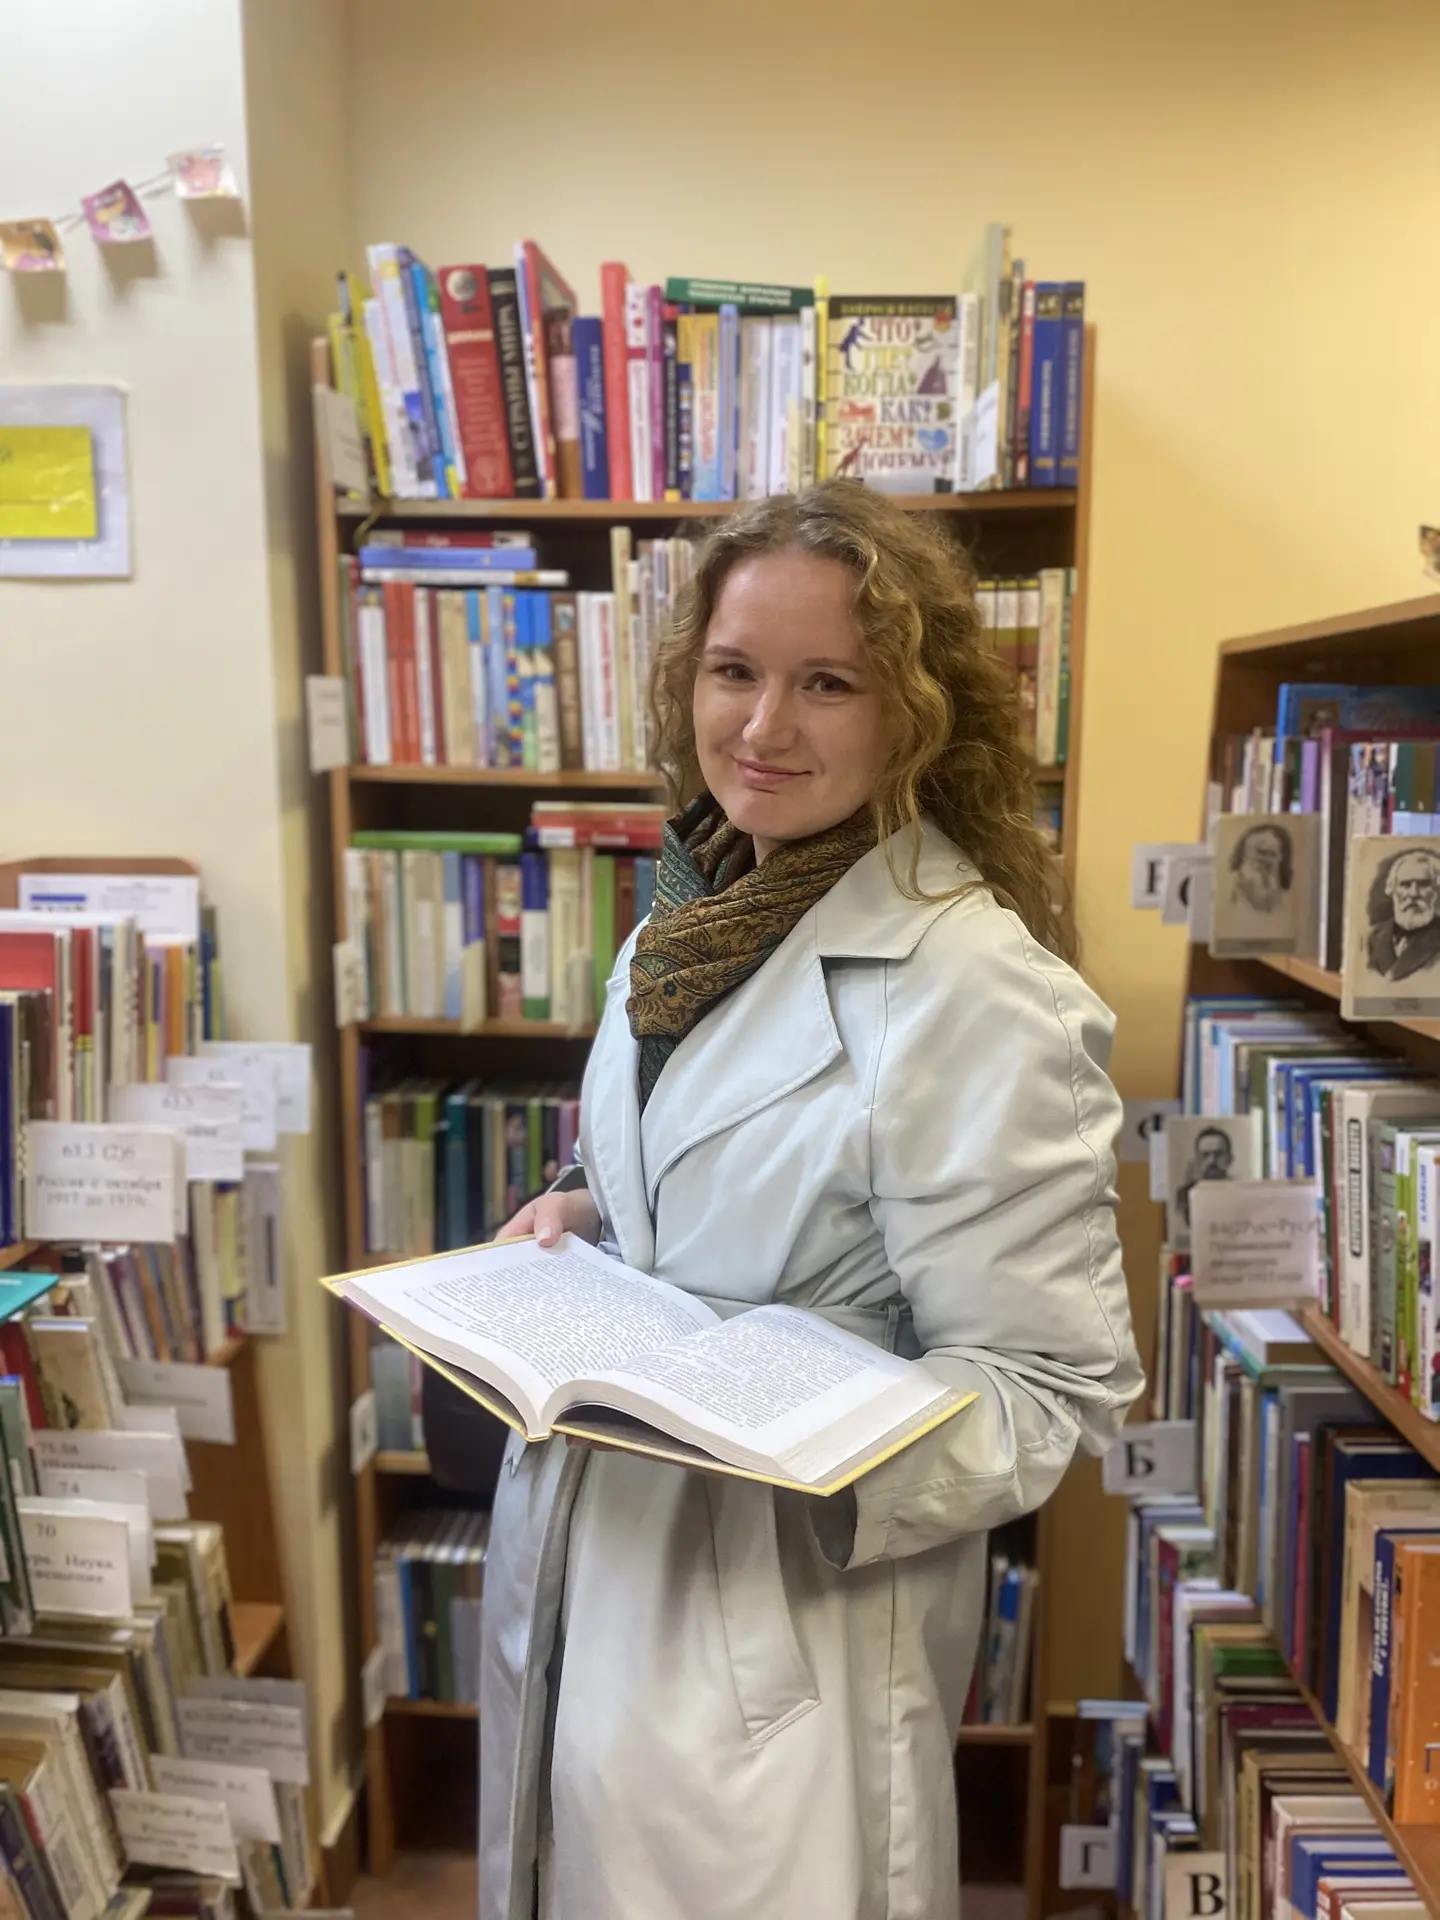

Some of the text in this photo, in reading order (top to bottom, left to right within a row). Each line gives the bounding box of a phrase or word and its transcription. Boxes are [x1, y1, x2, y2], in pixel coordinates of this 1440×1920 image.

[881, 398, 933, 424] КАК?
[1124, 1439, 1154, 1477] Б
[35, 1522, 57, 1538] 70
[1081, 1841, 1109, 1875] Г
[1187, 1872, 1228, 1917] В
